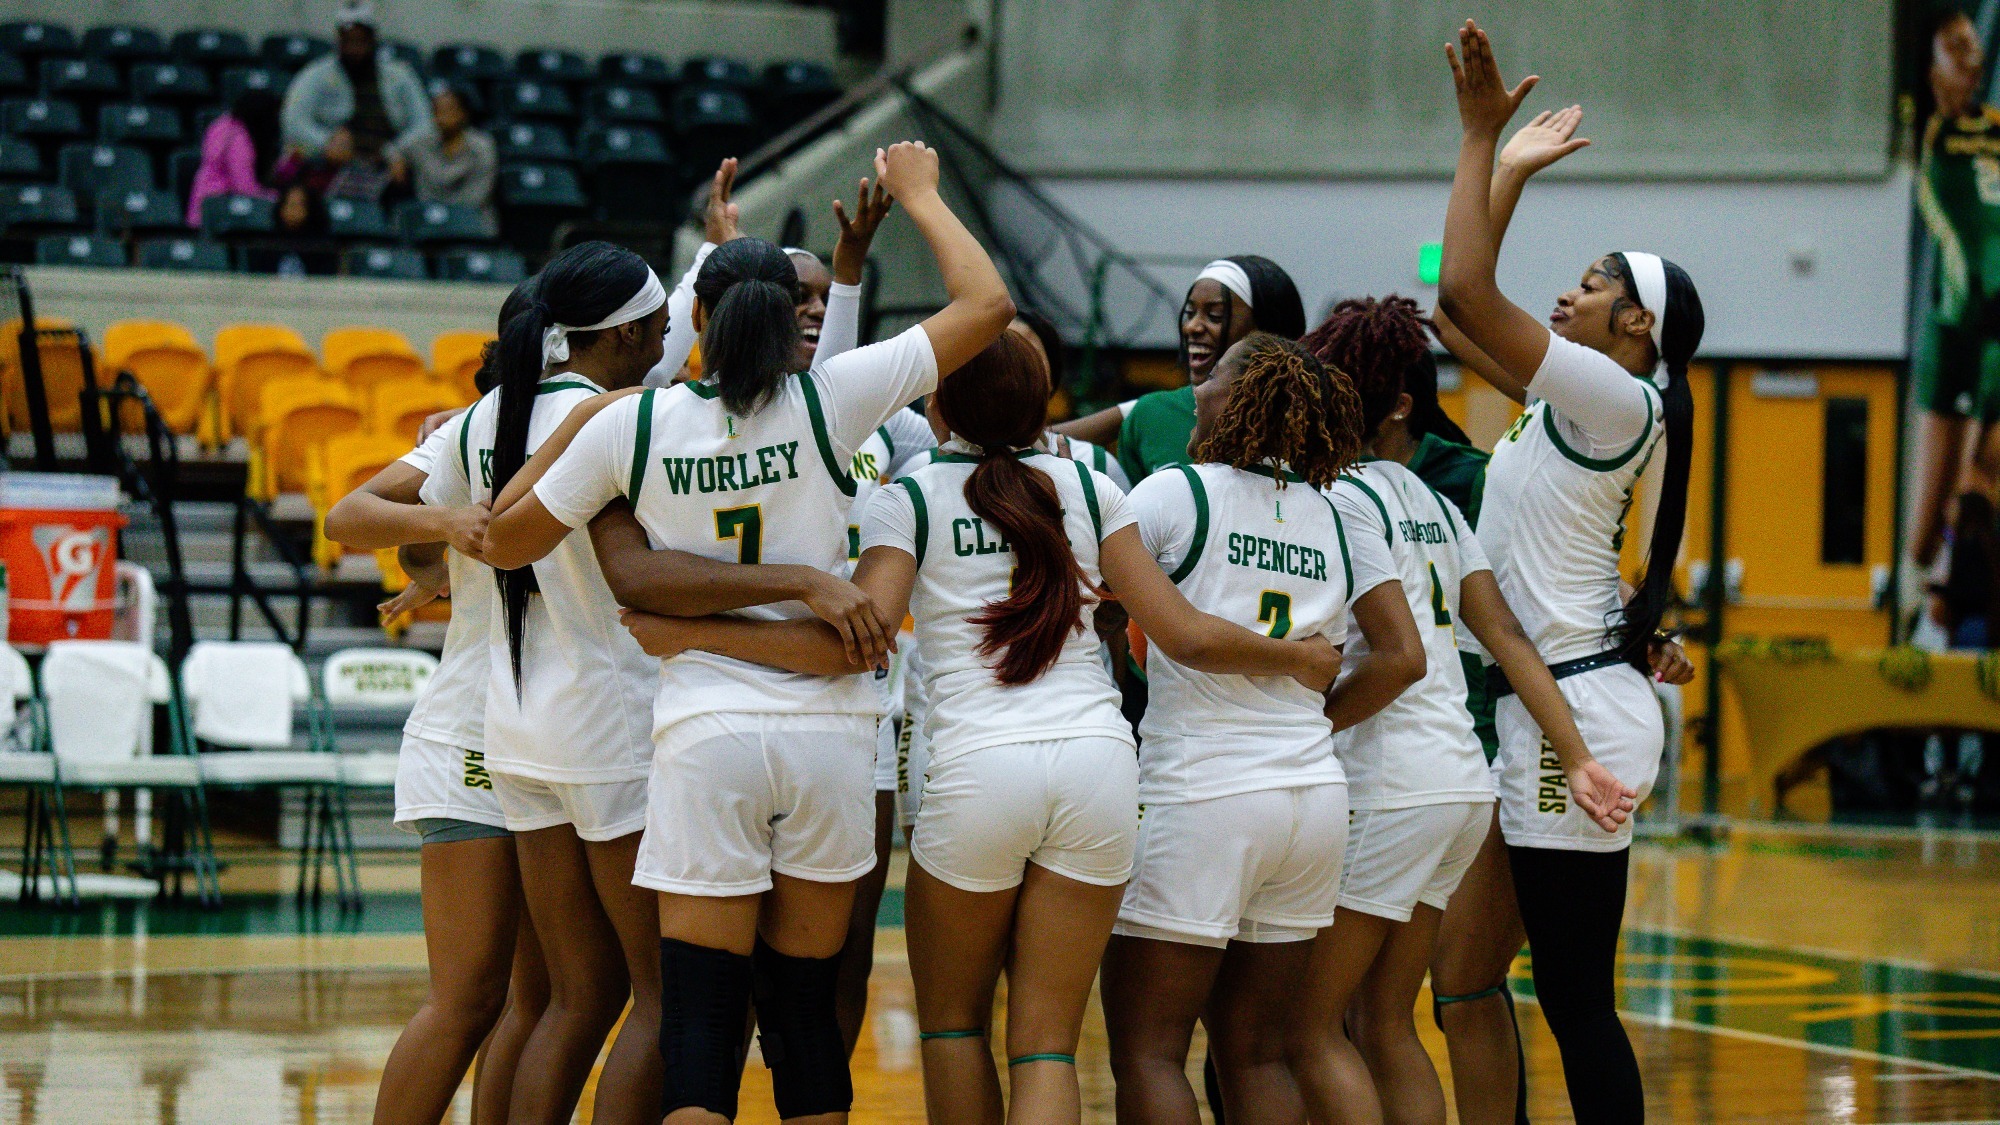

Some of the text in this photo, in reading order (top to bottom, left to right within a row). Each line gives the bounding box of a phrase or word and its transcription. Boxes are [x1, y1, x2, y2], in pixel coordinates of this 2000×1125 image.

[662, 440, 799, 495] WORLEY
[57, 532, 94, 575] G
[713, 502, 764, 565] 7
[1227, 531, 1328, 582] SPENCER
[897, 709, 915, 794] ARTANS
[1538, 733, 1568, 814] SPART
